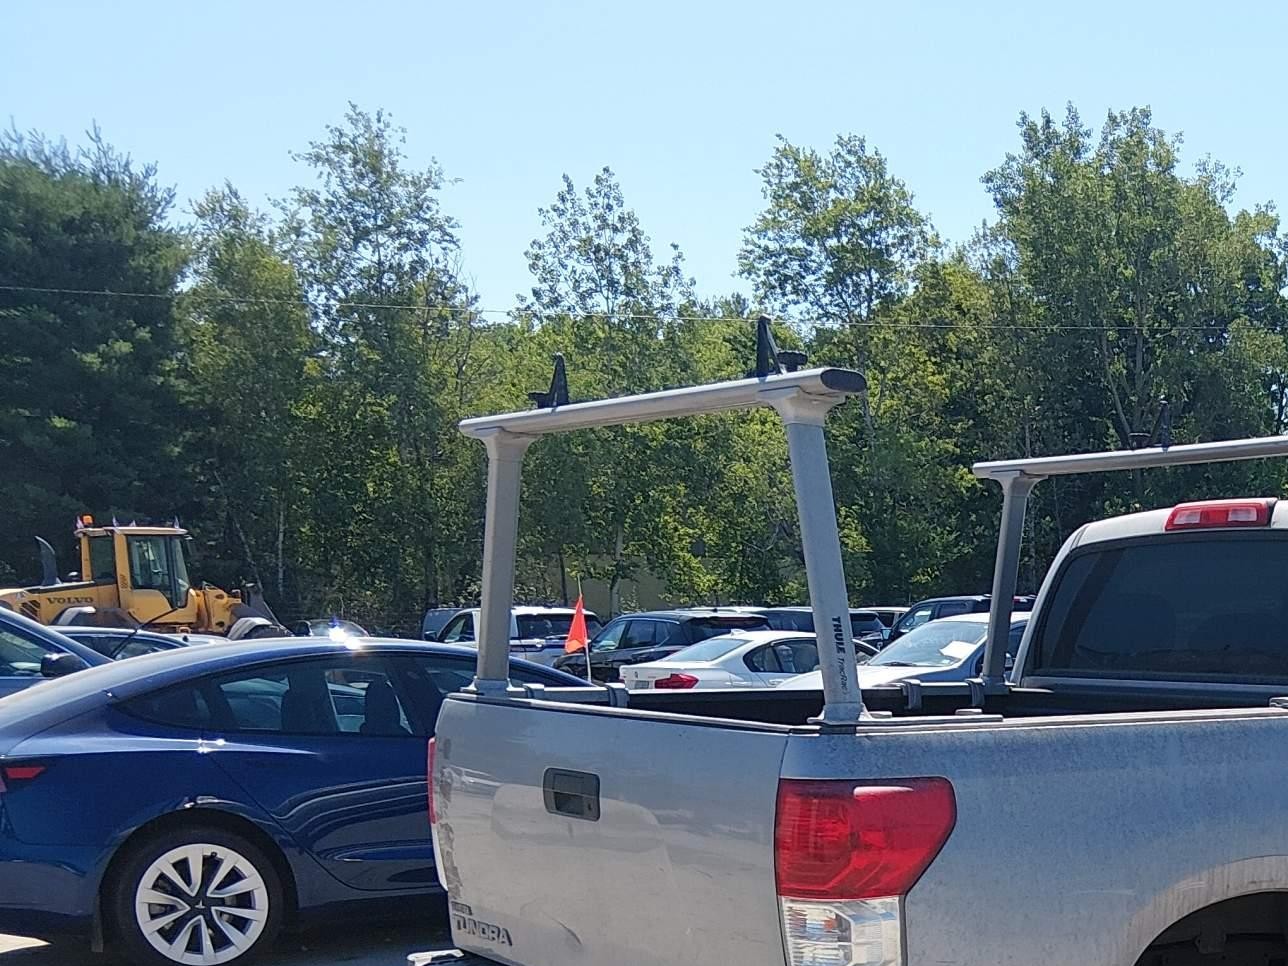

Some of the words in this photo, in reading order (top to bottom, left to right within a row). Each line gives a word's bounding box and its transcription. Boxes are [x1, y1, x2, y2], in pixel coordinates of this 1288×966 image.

[47, 596, 94, 605] VOLVO
[832, 616, 846, 654] THULE
[451, 912, 513, 946] TUNDRA
